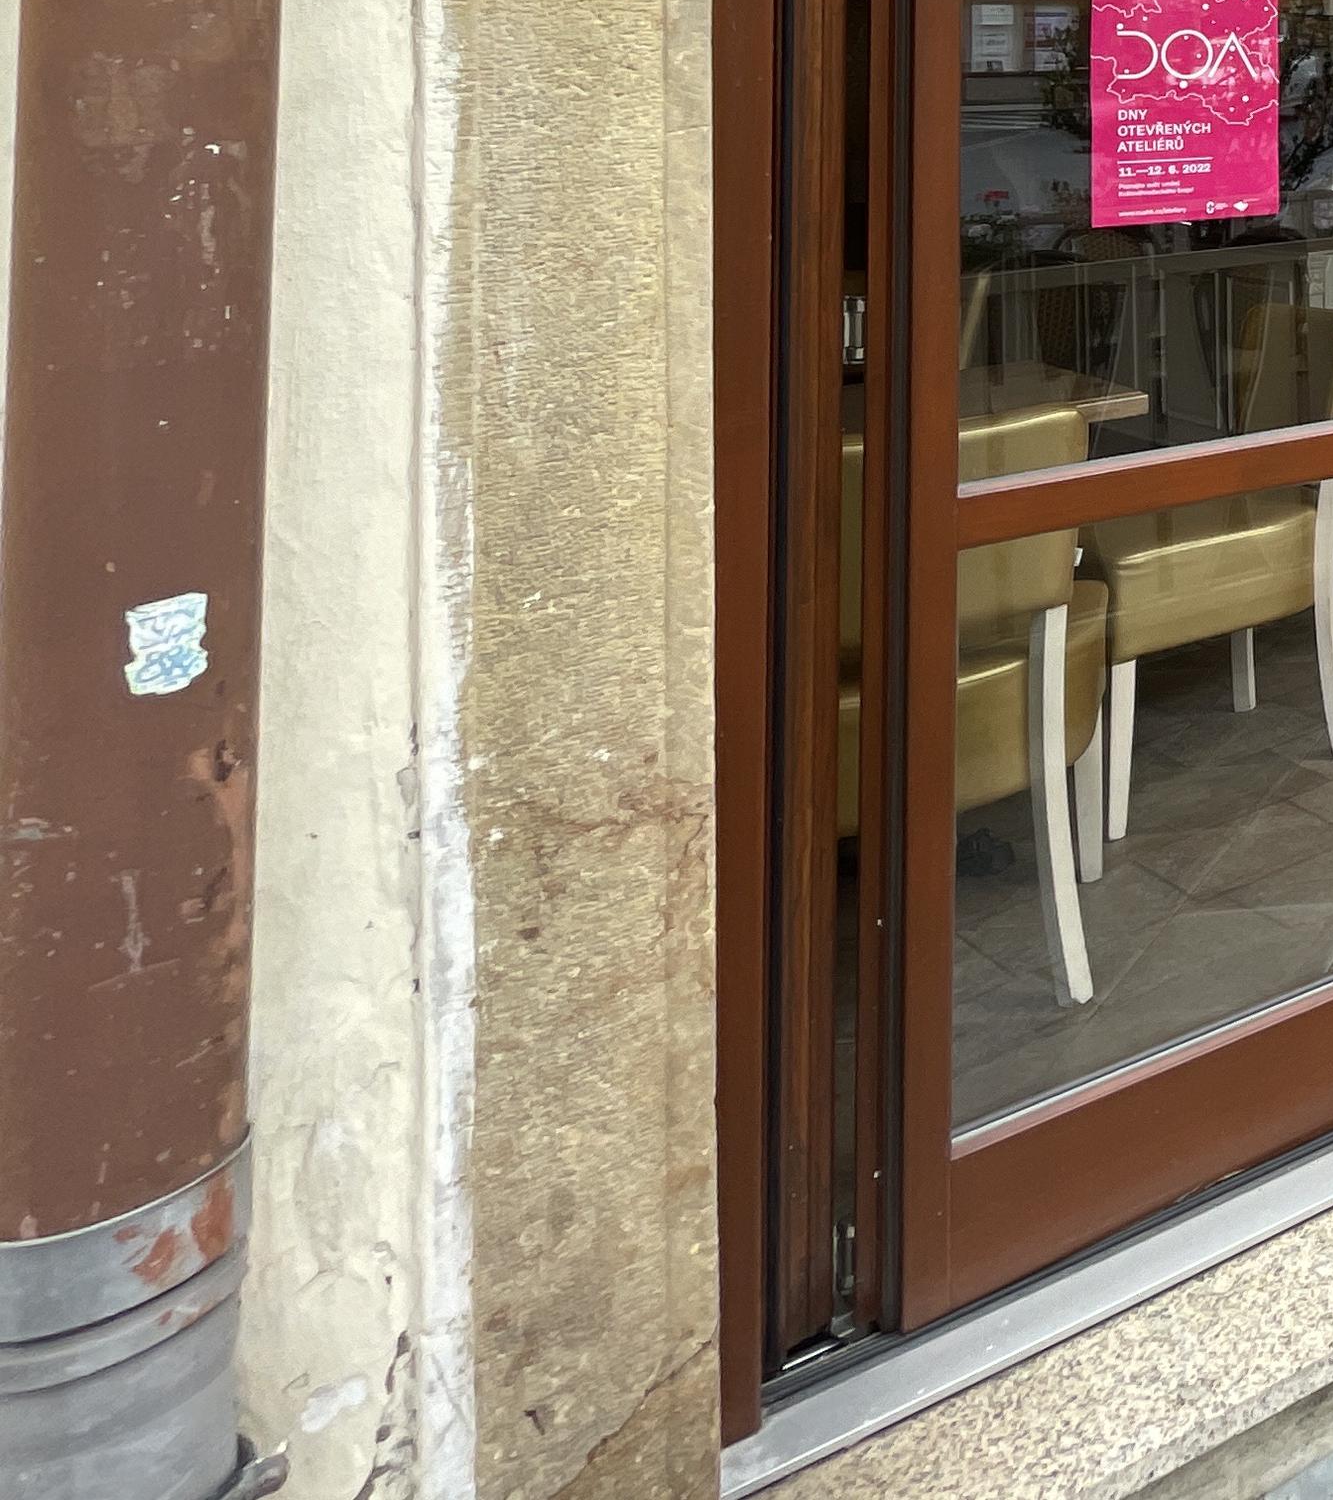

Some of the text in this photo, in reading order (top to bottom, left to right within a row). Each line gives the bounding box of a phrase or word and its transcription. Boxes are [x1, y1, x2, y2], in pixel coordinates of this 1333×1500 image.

[1118, 109, 1148, 121] DNY
[1117, 120, 1212, 136] OTEVŘENÝCH
[1117, 135, 1184, 152] ATELIÉRŮ
[1182, 163, 1212, 174] 2022
